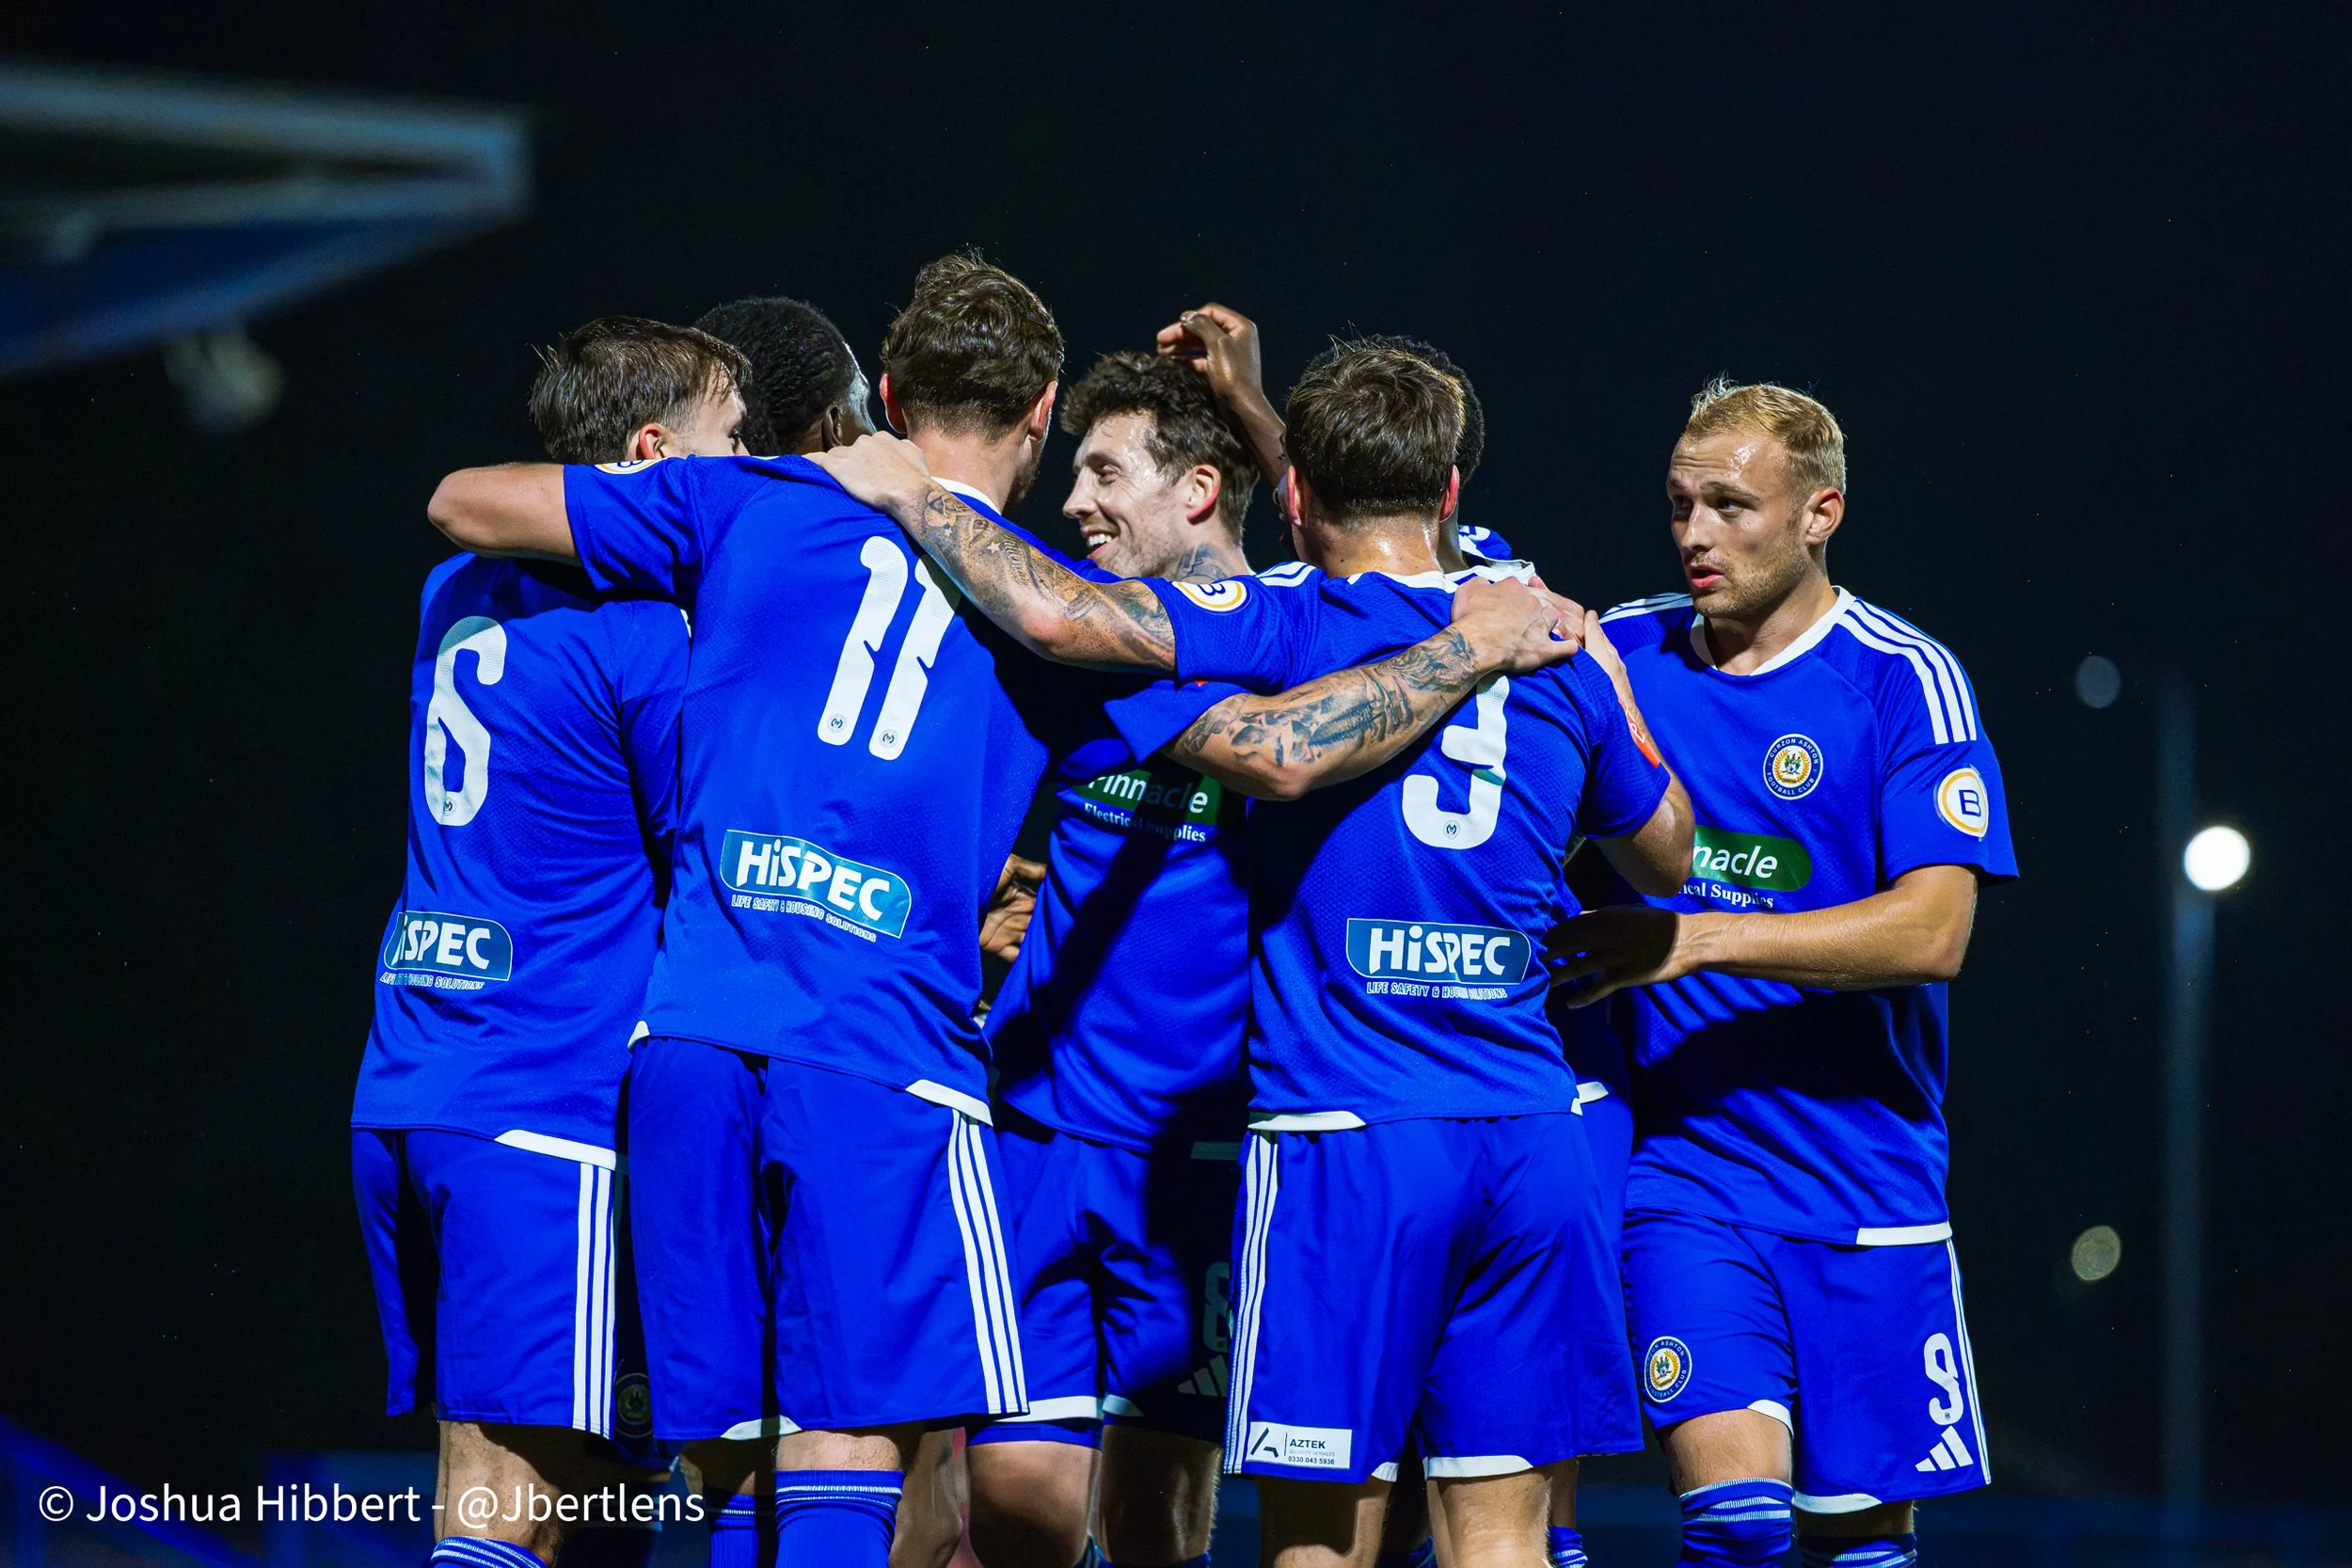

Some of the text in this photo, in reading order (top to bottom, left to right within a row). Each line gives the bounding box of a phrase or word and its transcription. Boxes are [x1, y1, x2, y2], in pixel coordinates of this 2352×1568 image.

[818, 536, 956, 761] 11
[424, 616, 507, 826] 6
[1403, 676, 1509, 849] 3
[1770, 738, 1819, 764] CURZON ASHTON
[1767, 771, 1815, 795] FOOTBALL CLUB
[1959, 789, 1981, 817] B
[1693, 846, 1778, 879] nacle
[737, 839, 890, 922] HiSPEC
[1710, 884, 1773, 908] Supplies
[731, 895, 751, 909] LIFE
[786, 900, 825, 920] HOUSING
[826, 913, 877, 942] SOLUTIONS
[1369, 925, 1510, 975] HiSPEC
[435, 976, 485, 990] SOLUTIONS
[1367, 982, 1389, 994] LIFE
[1391, 983, 1430, 997] SAFETY
[1431, 987, 1439, 998] &
[1924, 1333, 1964, 1425] 9
[1290, 1439, 1326, 1449] AZTEK
